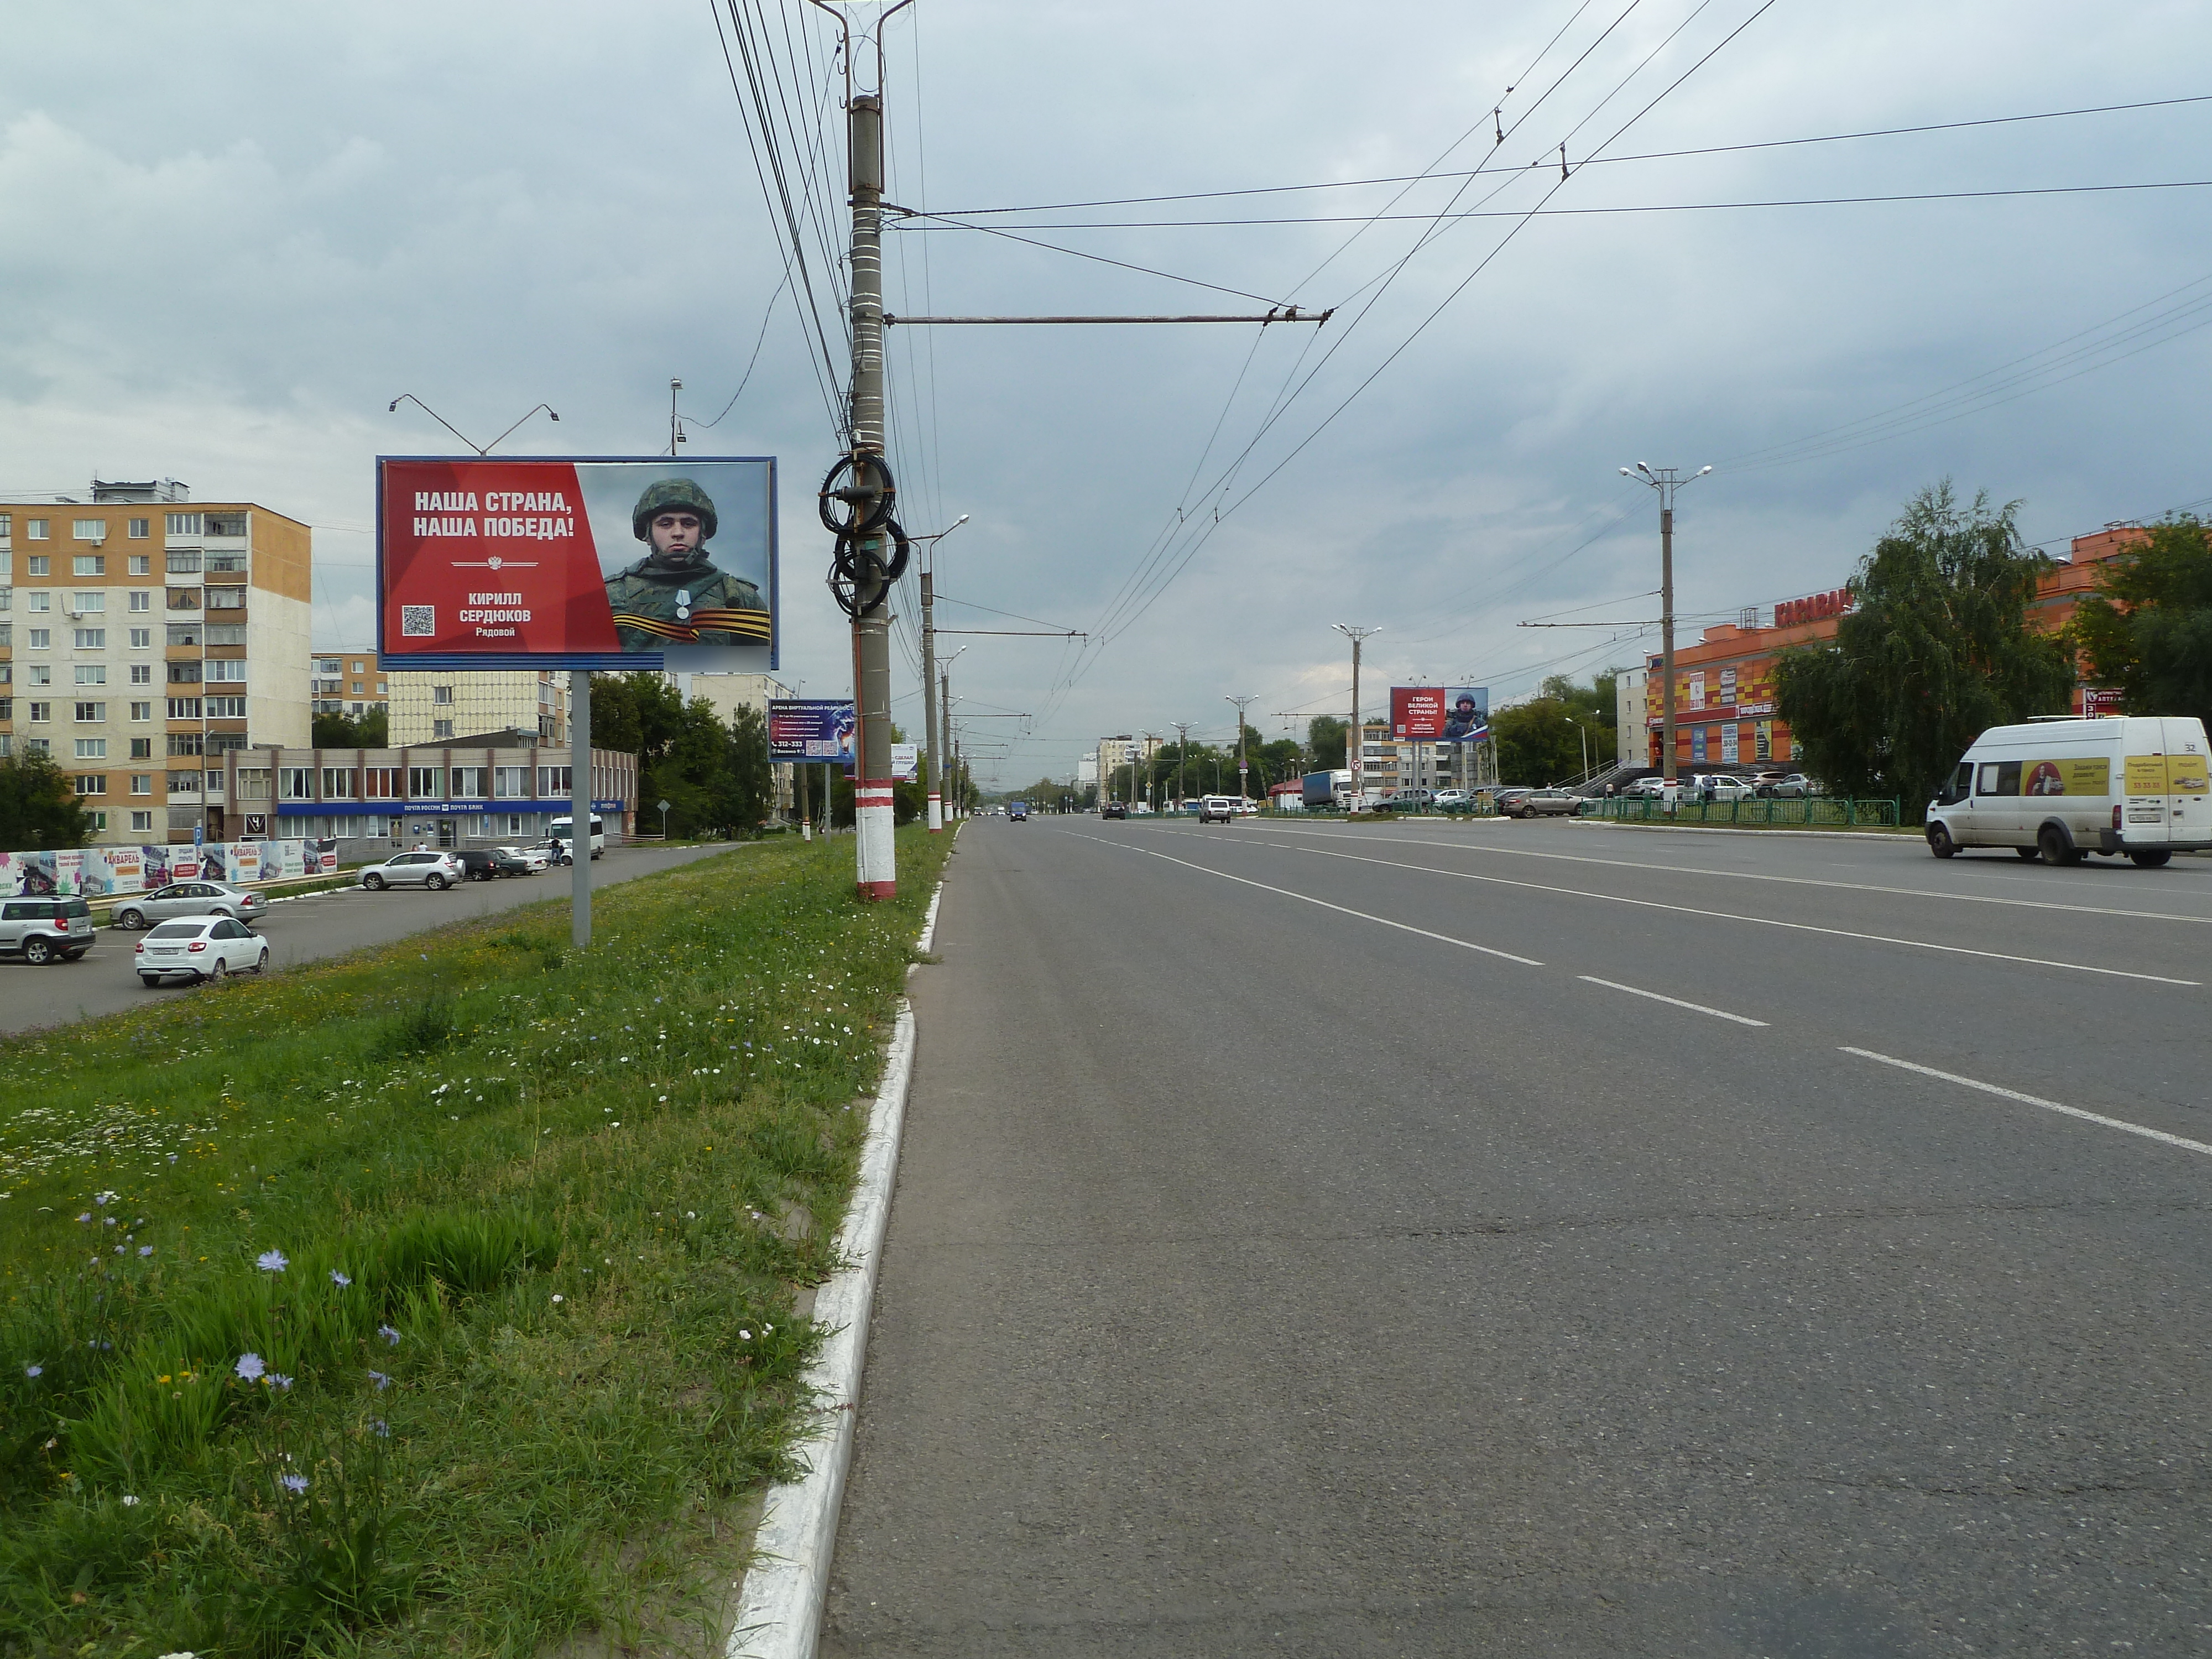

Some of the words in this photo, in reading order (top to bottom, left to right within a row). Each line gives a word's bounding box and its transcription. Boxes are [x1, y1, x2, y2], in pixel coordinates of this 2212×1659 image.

[415, 492, 478, 511] НАША
[486, 492, 572, 514] СТРАНА,
[414, 518, 477, 536] НАША
[484, 518, 574, 540] ПОБЕДА!
[468, 593, 521, 605] КИРИЛЛ
[460, 610, 531, 624] СЕРДЮКОВ
[476, 627, 515, 638] Рядовой
[2185, 744, 2195, 752] 32
